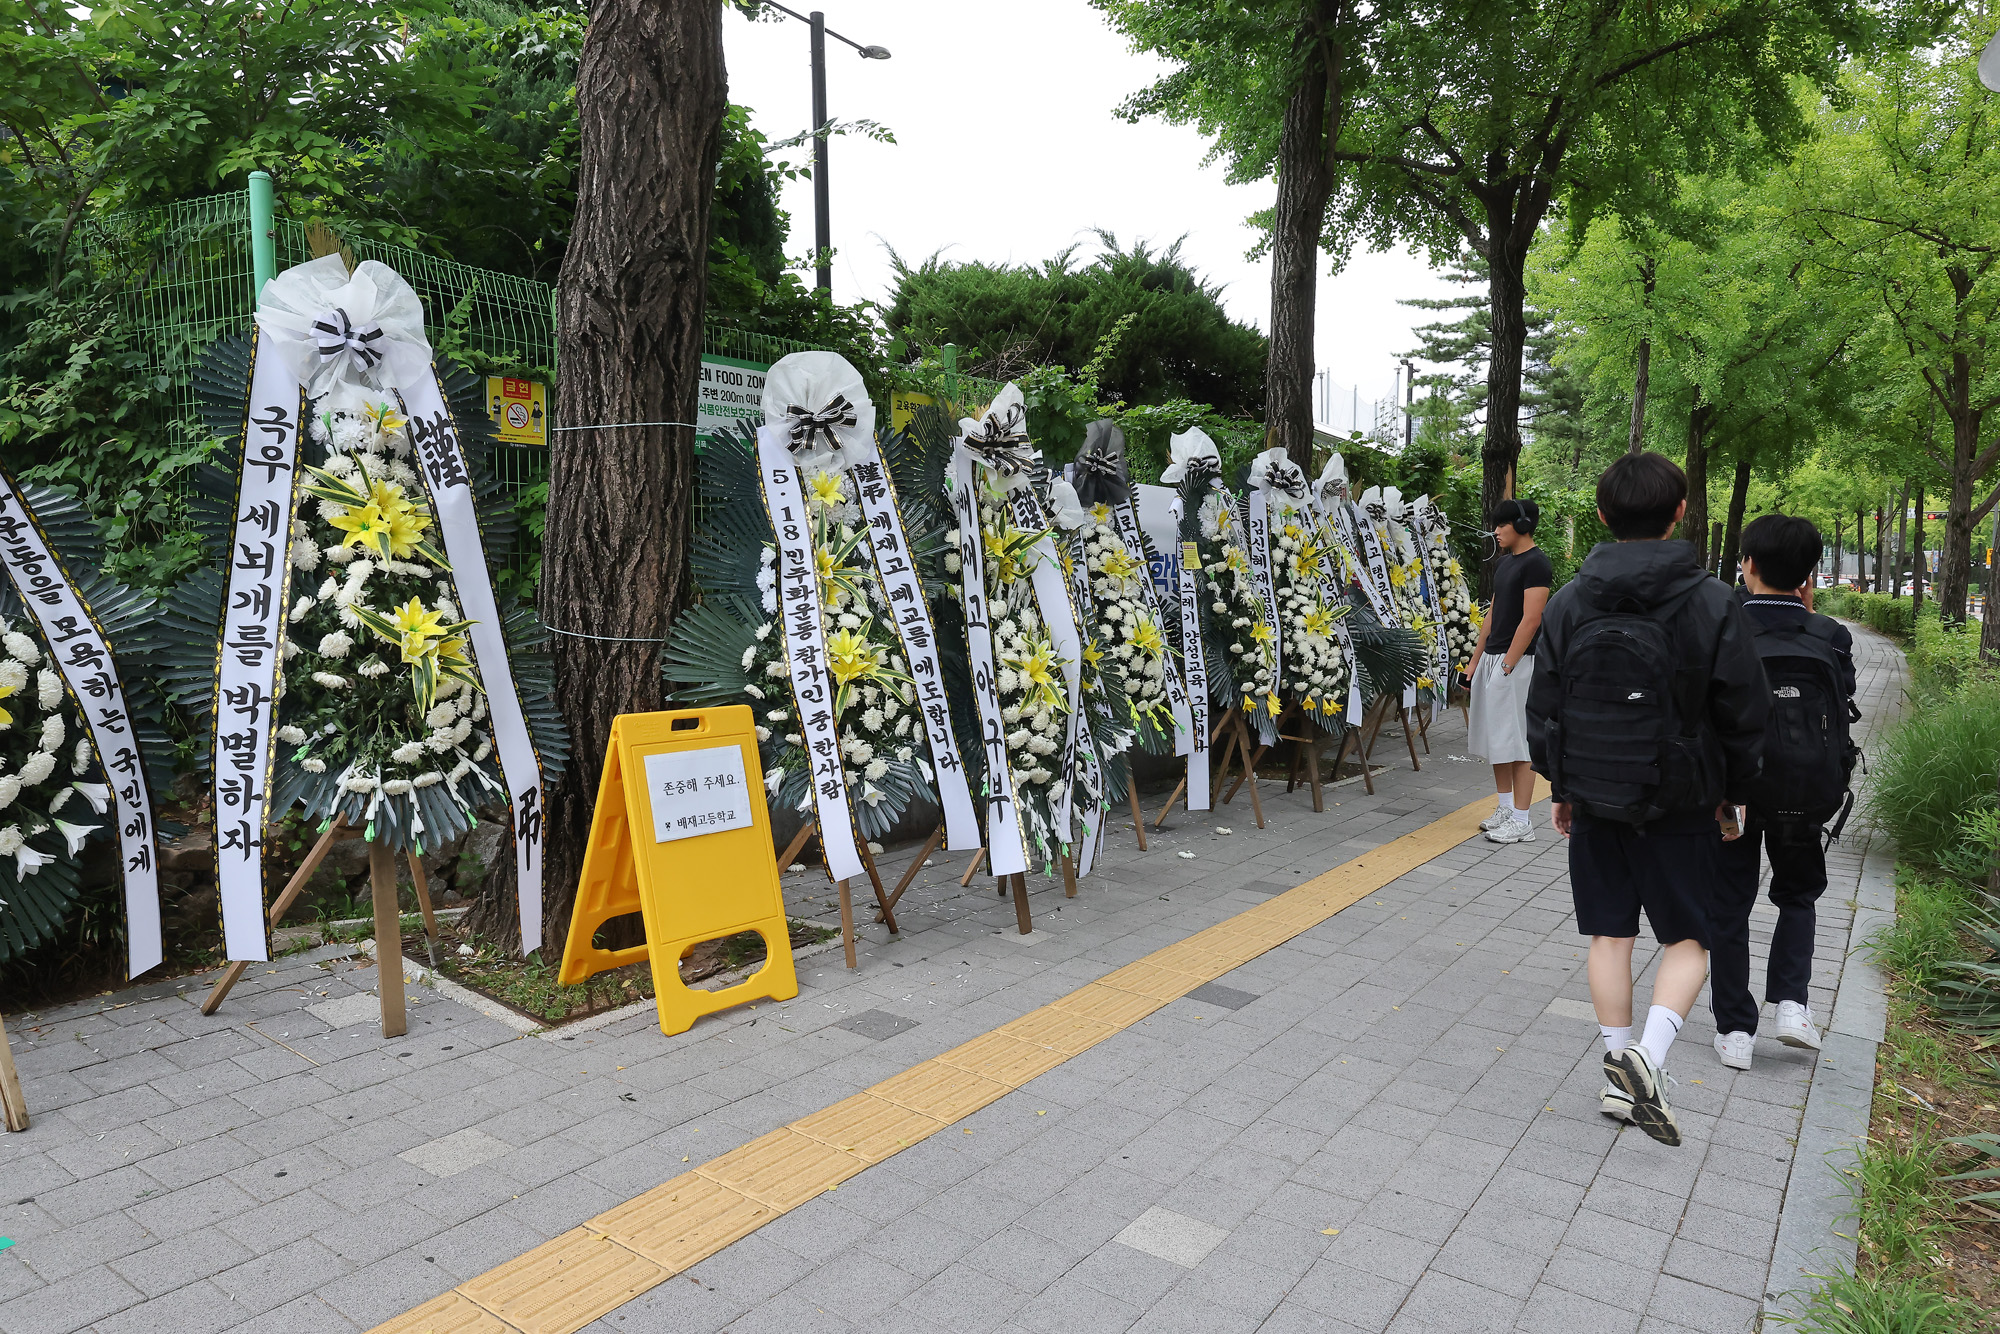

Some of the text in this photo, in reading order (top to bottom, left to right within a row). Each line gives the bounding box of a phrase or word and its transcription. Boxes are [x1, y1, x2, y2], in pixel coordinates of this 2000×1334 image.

[702, 387, 718, 400] 주변
[720, 390, 744, 403] 200m
[716, 370, 742, 386] FOOD
[854, 461, 886, 505] 謹弔
[868, 511, 909, 576] 배재고
[1358, 518, 1381, 559] 배재고
[1182, 581, 1196, 625] 쓰레기
[218, 406, 294, 862] 극우 세뇌개를 박멸하자
[413, 410, 542, 872] 謹 弔
[958, 483, 1010, 824] 배재고 야구부
[807, 709, 831, 732] 중
[915, 656, 960, 773] 애도합니다
[51, 615, 125, 734] 모욕하는
[110, 747, 151, 873] 국민에게
[663, 773, 740, 796] 존중해 주세요.
[677, 810, 737, 830] 배재고등학교
